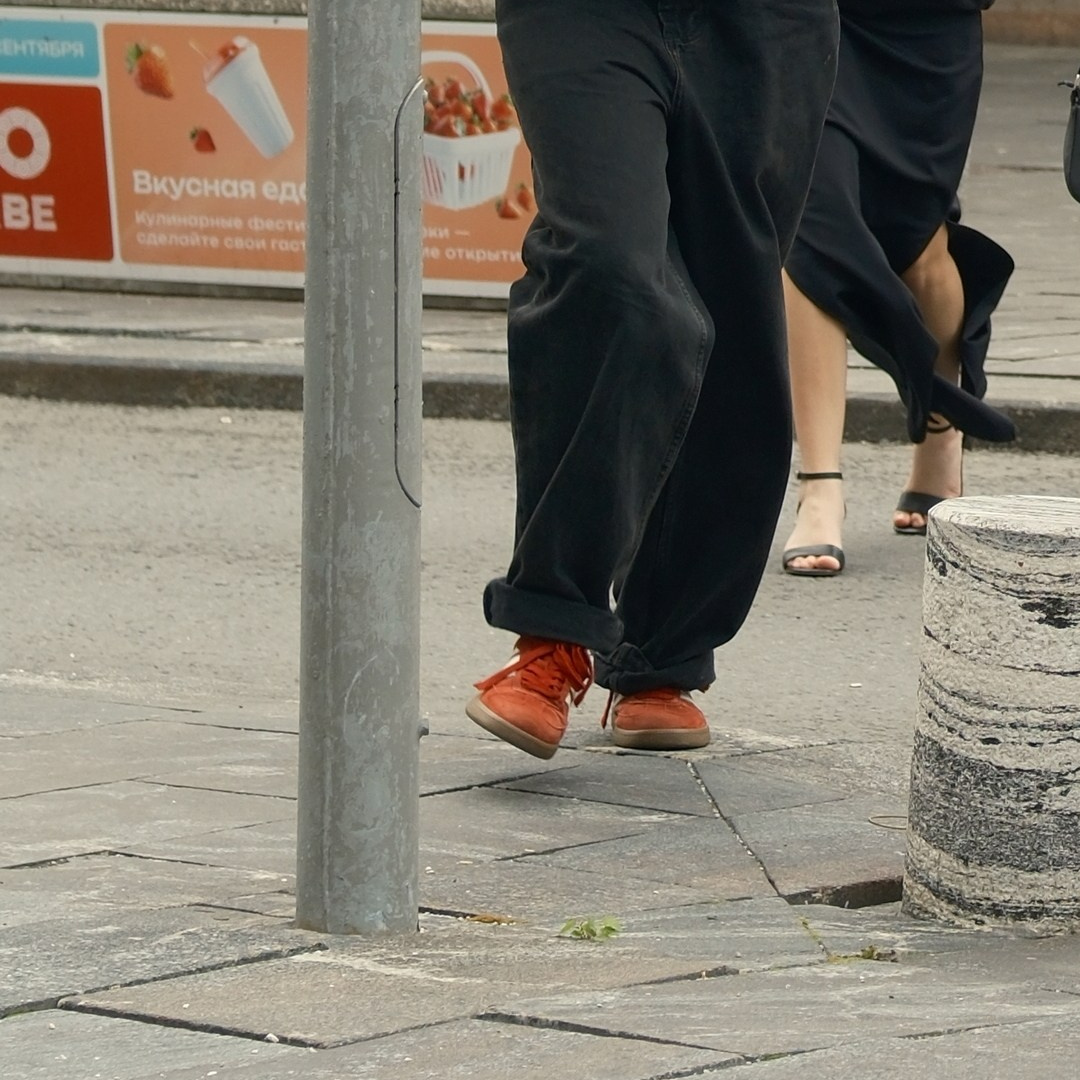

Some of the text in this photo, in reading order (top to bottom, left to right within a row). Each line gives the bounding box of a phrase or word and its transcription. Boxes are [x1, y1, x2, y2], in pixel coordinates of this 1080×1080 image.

[0, 37, 84, 59] ЕНТЯБРЯ
[133, 168, 256, 201] Вкусная
[0, 192, 57, 232] ВЕ
[135, 210, 242, 229] Кулинарные
[137, 231, 219, 248] сделайте
[224, 235, 266, 251] свои
